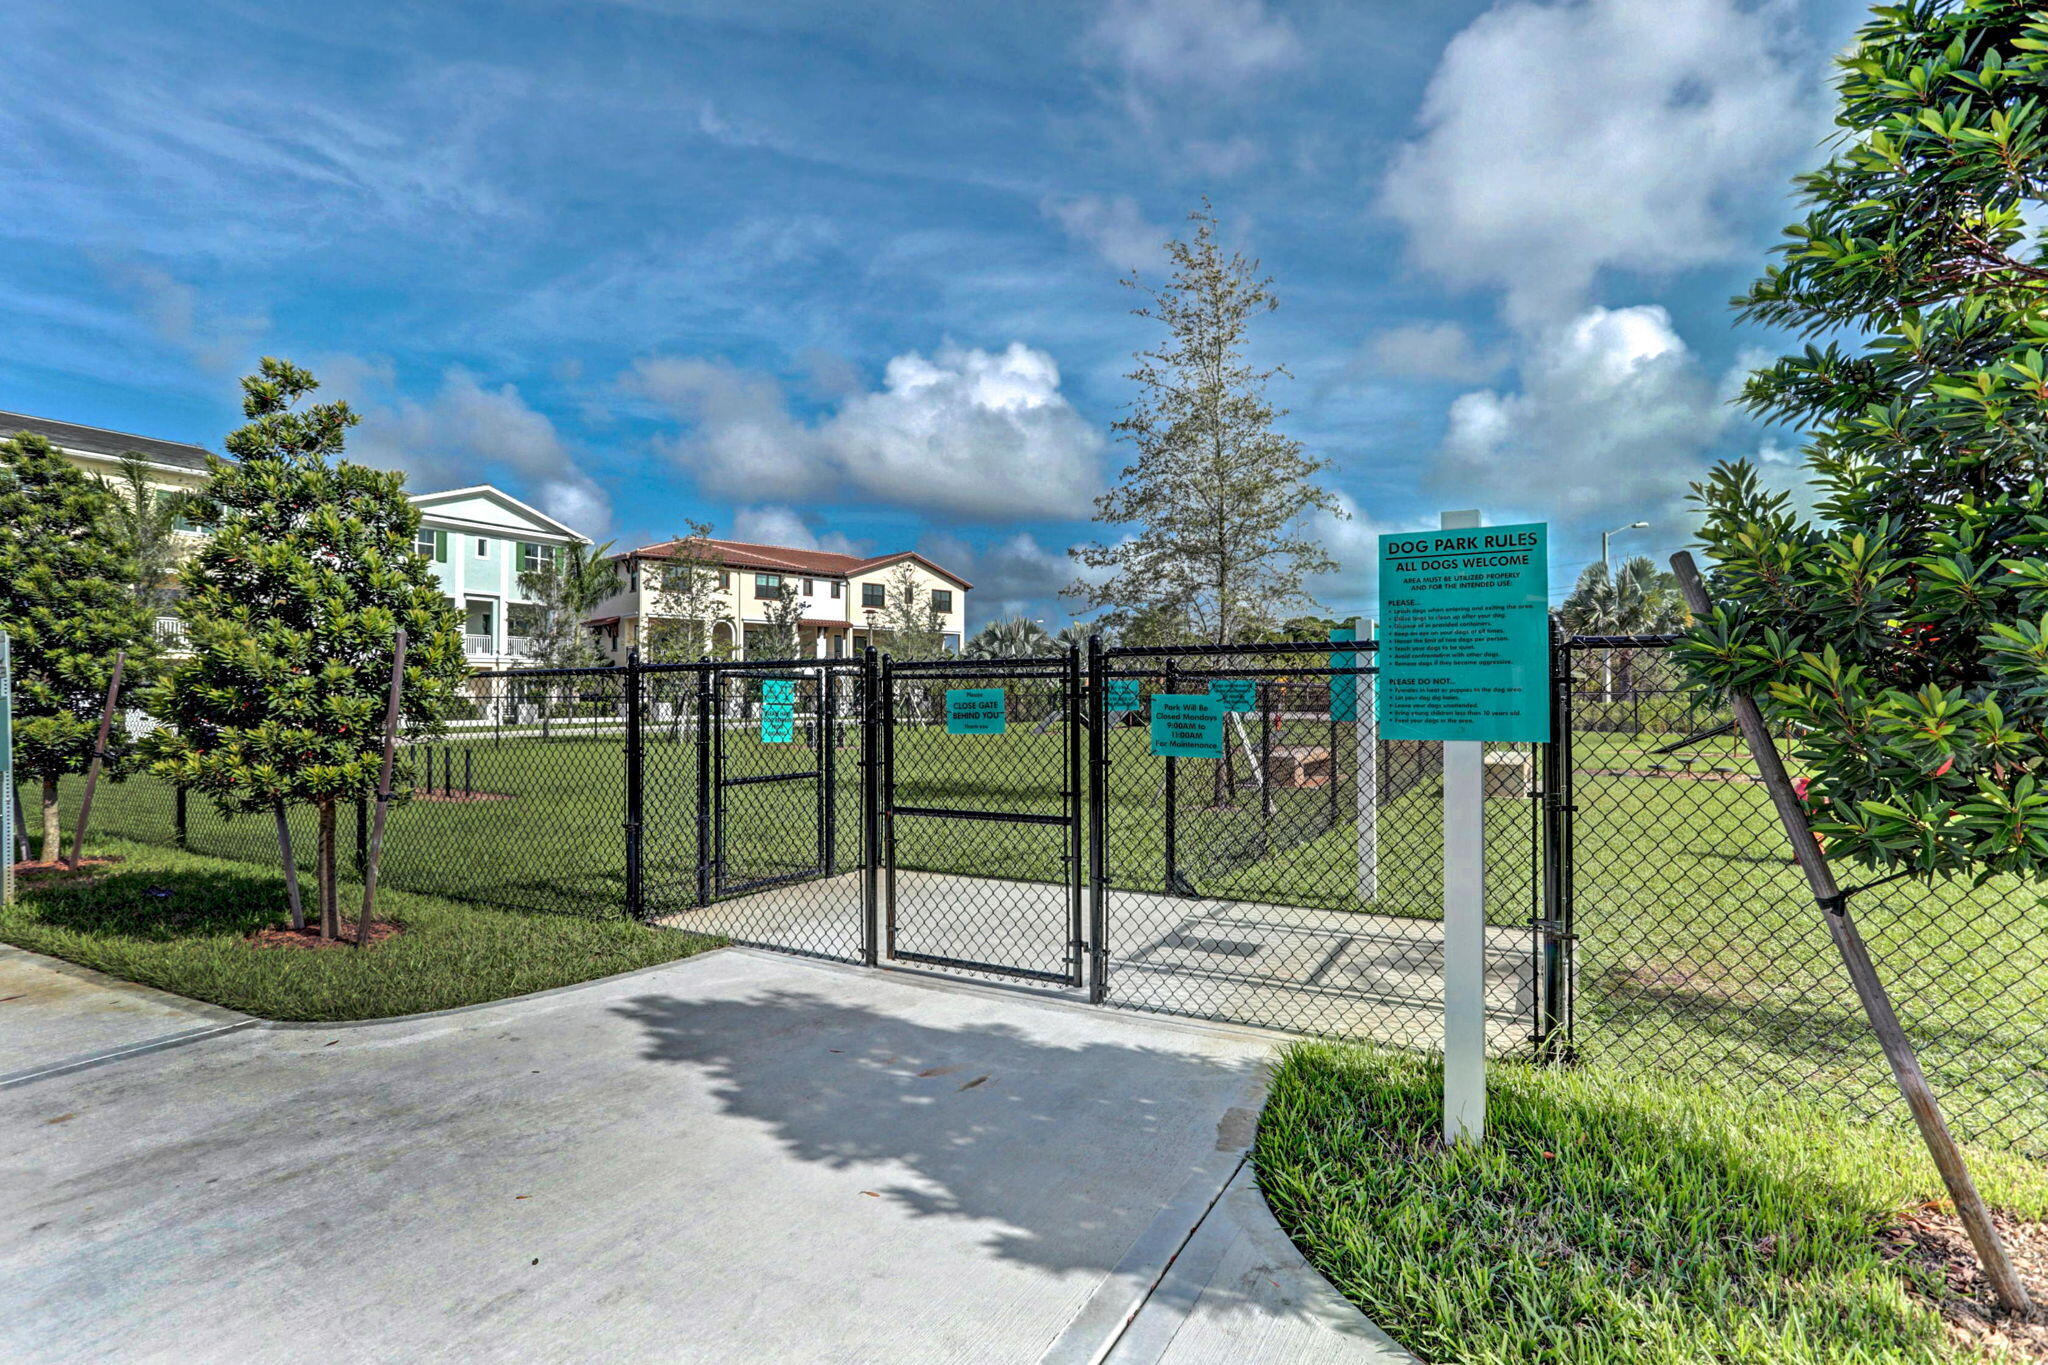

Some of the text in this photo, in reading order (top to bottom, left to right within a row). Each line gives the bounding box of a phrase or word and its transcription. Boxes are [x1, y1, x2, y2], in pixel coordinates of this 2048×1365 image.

[1388, 532, 1538, 554] DOG PARK RULES
[1396, 555, 1529, 572] ALL DOGS WELCOME
